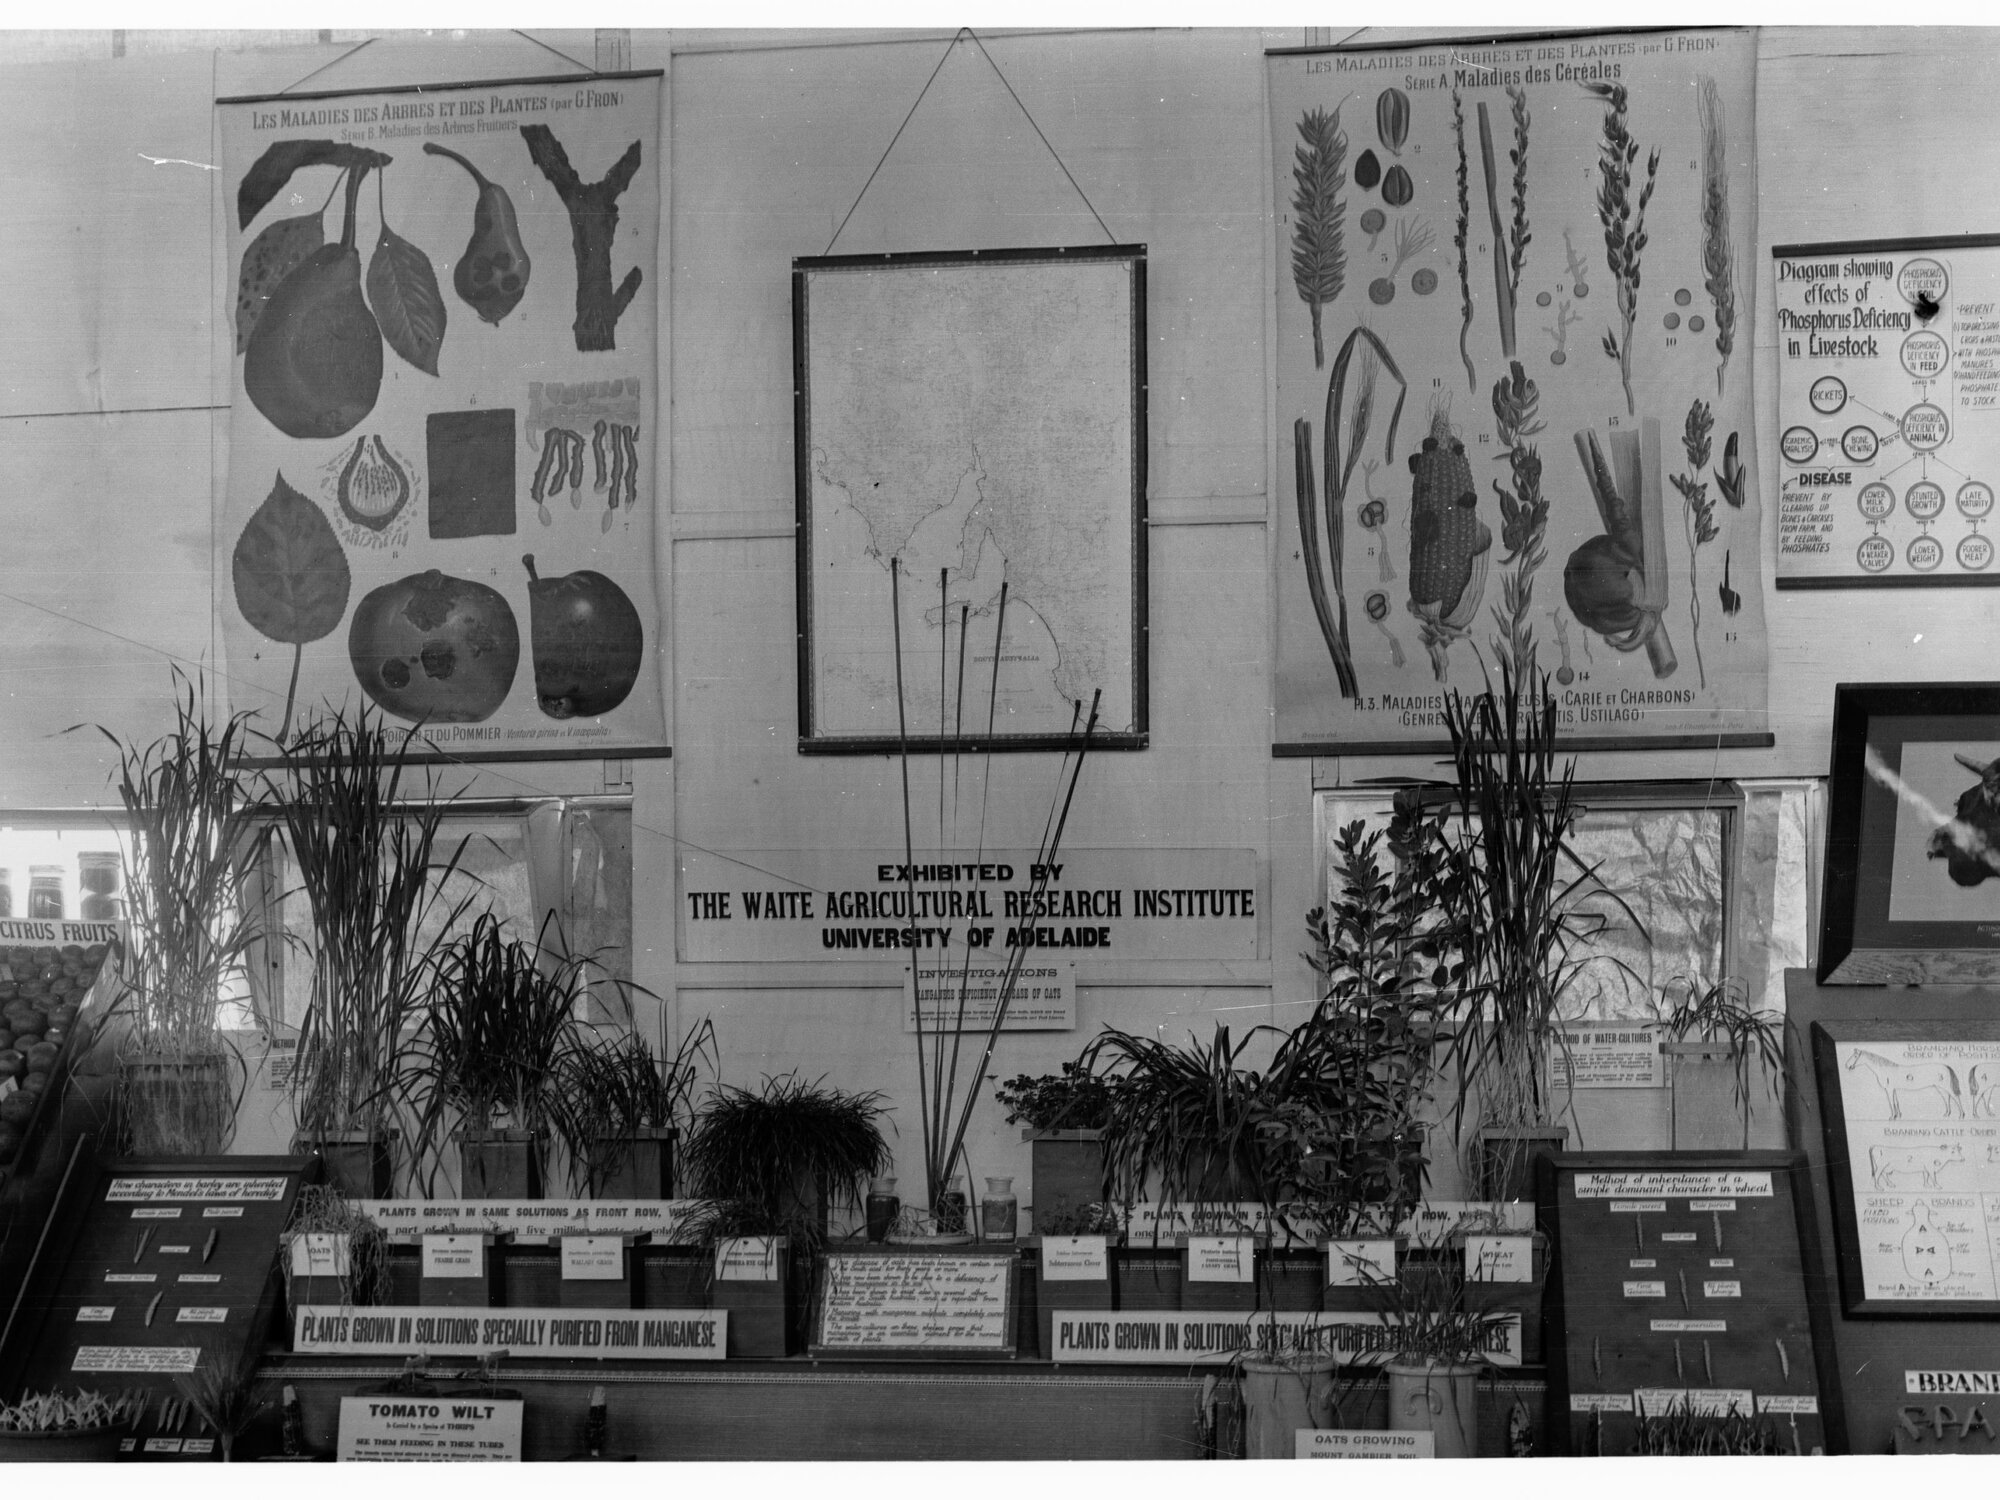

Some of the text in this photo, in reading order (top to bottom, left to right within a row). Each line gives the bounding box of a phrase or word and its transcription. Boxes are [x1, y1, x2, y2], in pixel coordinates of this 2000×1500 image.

[1306, 42, 1635, 74] LES MALADIES DES ARBRES ET DES PLANTES
[1454, 68, 1520, 88] Maladies
[1526, 64, 1551, 84] des
[1556, 60, 1621, 81] Céréales
[253, 96, 548, 130] LES MALADIES DES ARBRES ET DES PLANTES
[379, 119, 518, 140] Maladies des Arbres Fruitiers
[1780, 258, 1893, 283] Diagram showing
[1904, 279, 1942, 290] DEFICIENCY
[1804, 281, 1871, 304] effects of
[1960, 304, 1996, 313] PREVENT
[1778, 306, 1911, 334] Phosphorus Deficiency
[1788, 334, 1879, 357] in Livestock
[1908, 350, 1940, 361] DEFICIENCY
[1920, 361, 1938, 371] FEED
[1813, 390, 1843, 401] RICKETS
[1974, 396, 1997, 406] STOCK
[1851, 436, 1869, 445] BONE
[1910, 433, 1939, 443] ANIMAL
[1845, 444, 1873, 453] CHEWING
[1799, 472, 1852, 487] DISEASE
[1782, 492, 1832, 502] PREVENT BY
[1864, 490, 1886, 500] LOWER
[1912, 491, 1938, 501] STUNTED
[1964, 490, 1982, 500] LATE
[1866, 498, 1884, 506] MILK
[1911, 500, 1938, 510] GROWTH
[1960, 499, 1989, 509] MATURITY
[1782, 503, 1830, 513] CLEARING UP
[1866, 505, 1885, 514] YIELD
[1781, 514, 1834, 524] BONES CARCASES
[1780, 524, 1834, 534] FROM AND
[1782, 534, 1823, 544] BY FEEDING
[1782, 544, 1830, 554] PHOSPHATES
[1866, 542, 1885, 551] FEWER
[1914, 546, 1936, 555] LOWER
[1963, 544, 1988, 554] POORER
[1866, 550, 1889, 559] WEAKER
[1912, 554, 1936, 563] WEIGHT
[1964, 552, 1984, 562] MEAT
[1864, 558, 1886, 568] CALVES
[1383, 688, 1696, 711] MALADIES (CARIE ET CHARBONS)
[1580, 707, 1645, 723] USTILAGO)
[453, 726, 501, 742] POMMIER
[878, 864, 1064, 882] EXHIBITED BY
[688, 889, 1255, 919] THE WAITE AGRICULTURAL RESEARCH INSTITUTE
[0, 921, 119, 942] CITRUS FRUITS
[822, 927, 1111, 949] UNIVERSITY OF ADELAIDE
[1044, 988, 1062, 1000] OATS
[1884, 1127, 1965, 1137] BRANDING CATTLE
[1590, 1173, 1729, 1185] Method of inheritance of
[114, 1180, 133, 1190] How
[1578, 1183, 1769, 1198] simple dominant character wheat
[378, 1207, 662, 1219] PLANTS GROWN IN SAME SOLUTIONS AS FRONT ROW,
[1143, 1211, 1451, 1222] PLANTS ROW,
[395, 1226, 419, 1235] part
[526, 1225, 546, 1235] five
[310, 1247, 331, 1255] OATS
[302, 1316, 717, 1348] PLANTS GROWN IN SOLUTIONS SPECIALLY PURIFIED FROM MANGANESE
[1060, 1322, 1252, 1351] PLANTS GROWN IN SOLUTIONS
[369, 1404, 495, 1419] TOMATO WILT
[356, 1438, 371, 1446] SEE
[374, 1438, 397, 1447] THEM
[400, 1439, 434, 1447] FEEDING
[450, 1440, 475, 1448] THESE
[478, 1441, 504, 1449] TUBES
[1315, 1434, 1416, 1446] OATS GROWING
